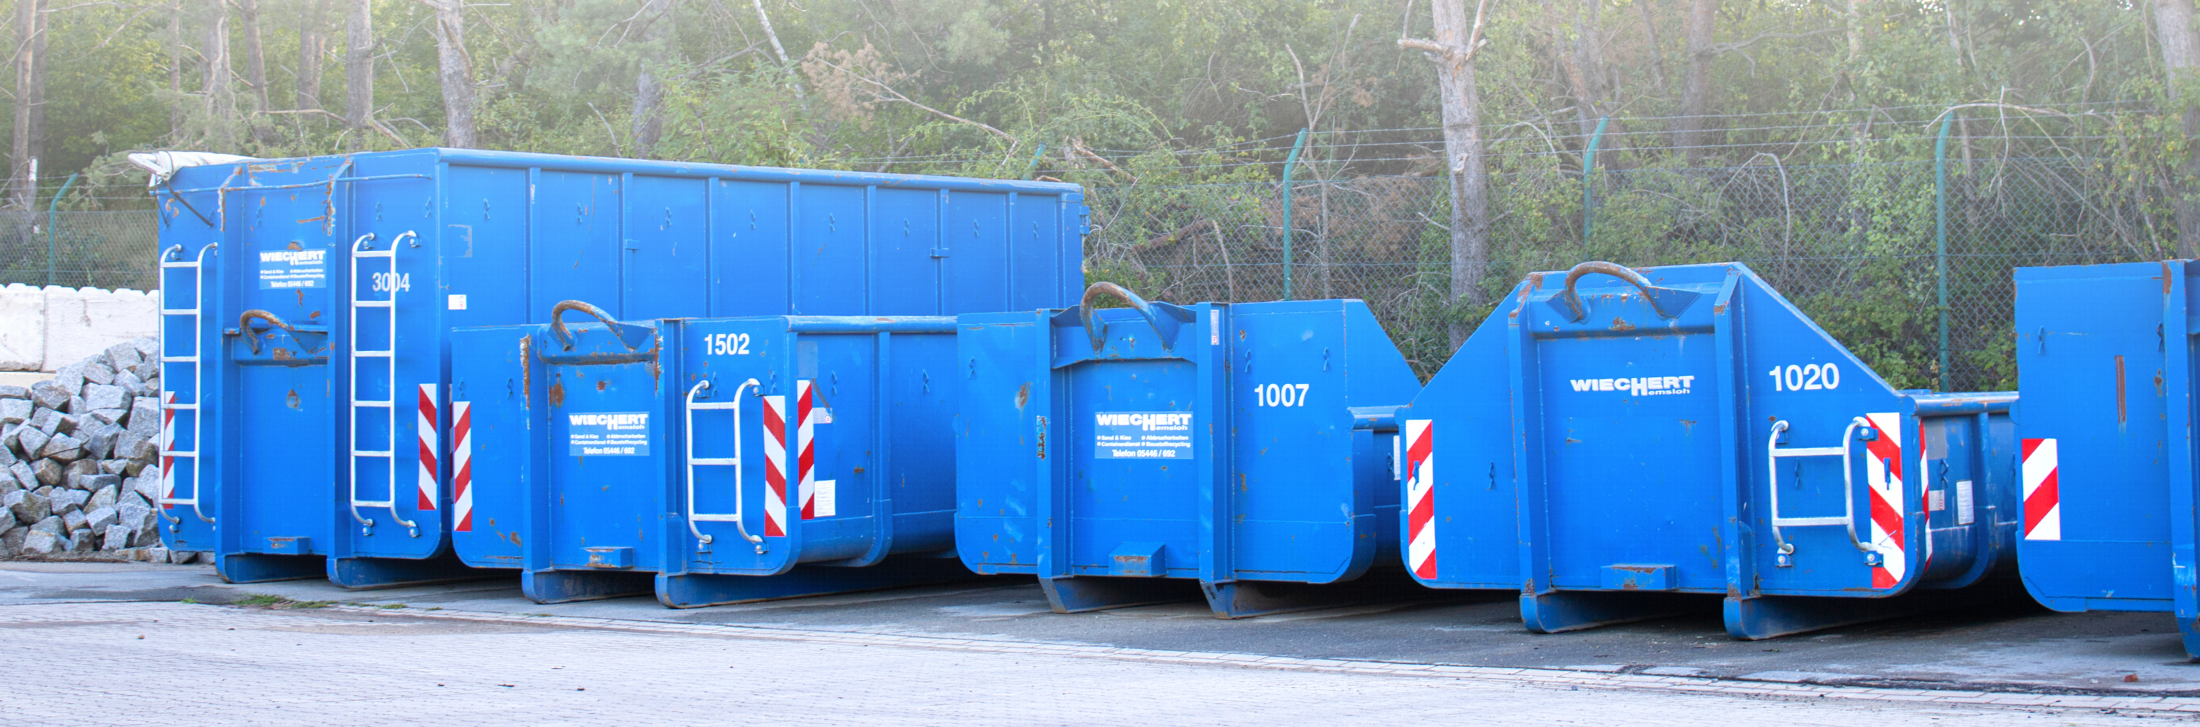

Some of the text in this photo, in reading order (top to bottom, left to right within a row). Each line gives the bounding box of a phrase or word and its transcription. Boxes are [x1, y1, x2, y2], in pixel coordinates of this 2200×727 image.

[260, 250, 326, 265] WIECHERT
[704, 333, 750, 355] 1502
[1570, 375, 1695, 396] WIECHERT
[1769, 362, 1841, 391] 1020
[1254, 383, 1310, 407] 1007
[569, 414, 648, 430] WIECHERT
[1096, 414, 1192, 431] WIECHERT
